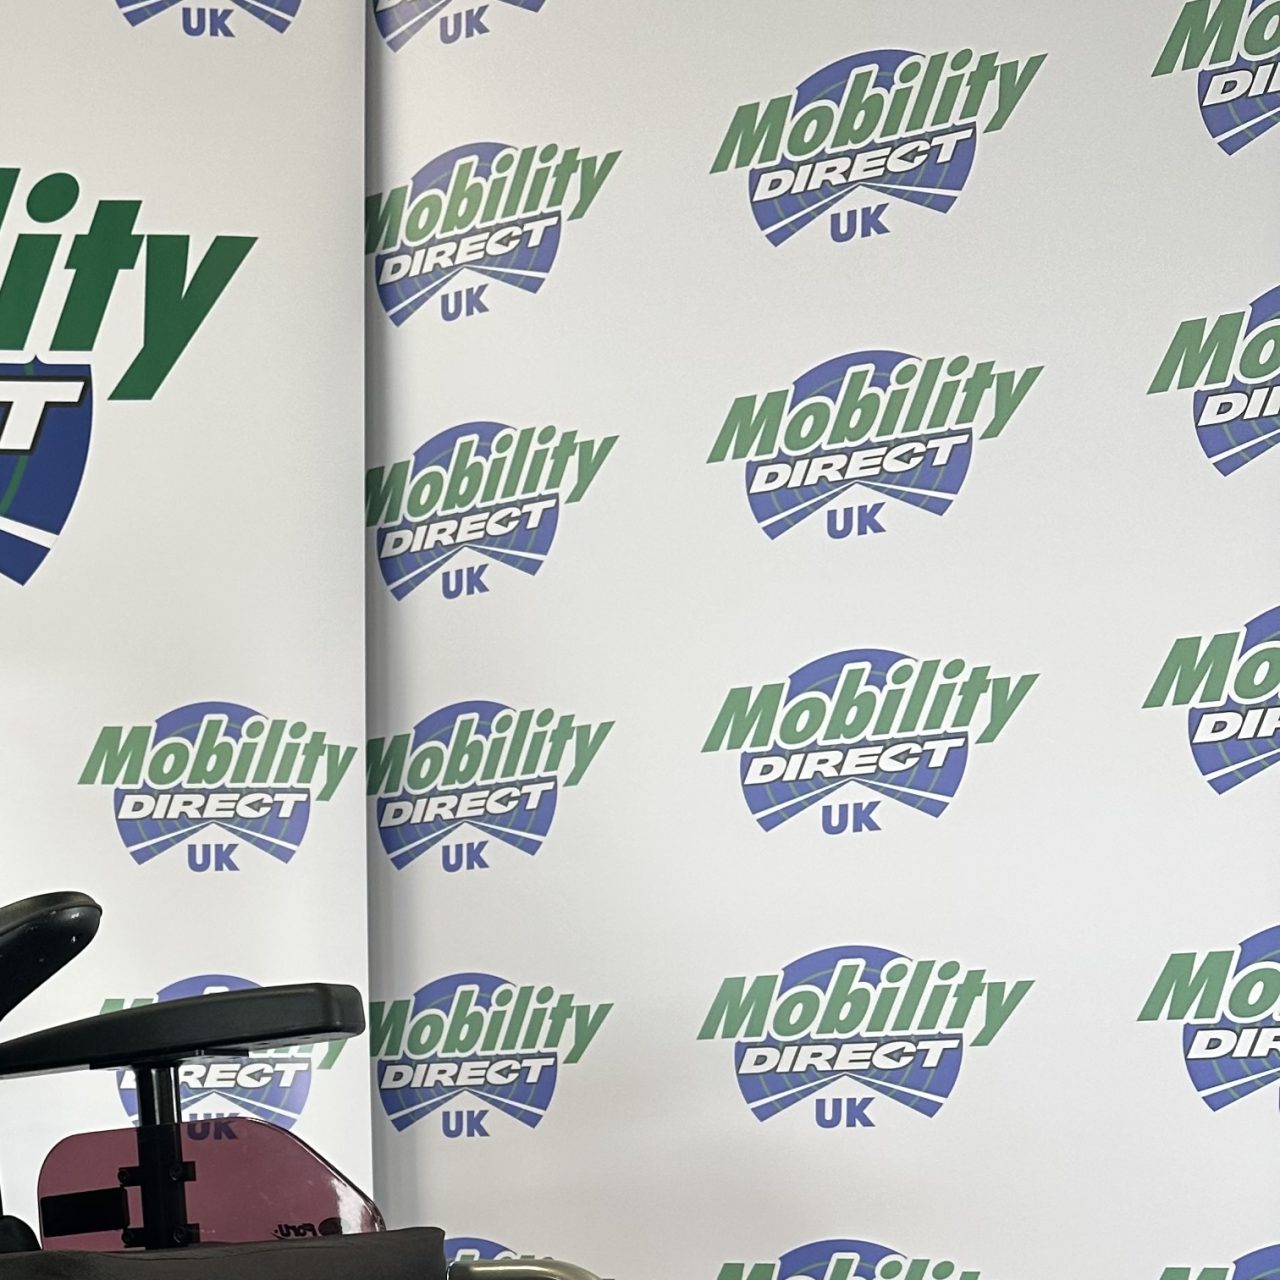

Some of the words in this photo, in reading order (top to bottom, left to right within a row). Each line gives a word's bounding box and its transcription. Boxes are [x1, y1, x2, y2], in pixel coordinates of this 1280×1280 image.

[181, 7, 236, 38] UK
[439, 4, 490, 45] UK
[709, 48, 1048, 174] Mobility
[752, 127, 973, 203] DIRECT
[365, 143, 623, 255] Mobility
[830, 203, 890, 243] UK
[378, 216, 559, 286] DIRECT
[440, 283, 490, 322] UK
[706, 355, 1045, 464] Mobility
[366, 425, 619, 528] Mobility
[749, 433, 969, 495] DIRECT
[380, 498, 557, 560] DIRECT
[826, 501, 887, 540] UK
[442, 563, 490, 600] UK
[700, 657, 1041, 753] Mobility
[77, 717, 358, 802] Mobility
[366, 708, 615, 797] Mobility
[743, 737, 966, 786] DIRECT
[117, 793, 309, 820] DIRECT
[380, 780, 554, 829] DIRECT
[821, 800, 882, 836] UK
[187, 843, 240, 873] UK
[442, 840, 490, 873] UK
[370, 986, 614, 1065] Mobility
[696, 960, 1036, 1049] Mobility
[381, 1057, 555, 1090] DIRECT
[738, 1038, 960, 1075] DIRECT
[186, 1112, 240, 1141] UK
[442, 1109, 491, 1138] UK
[815, 1096, 876, 1129] UK
